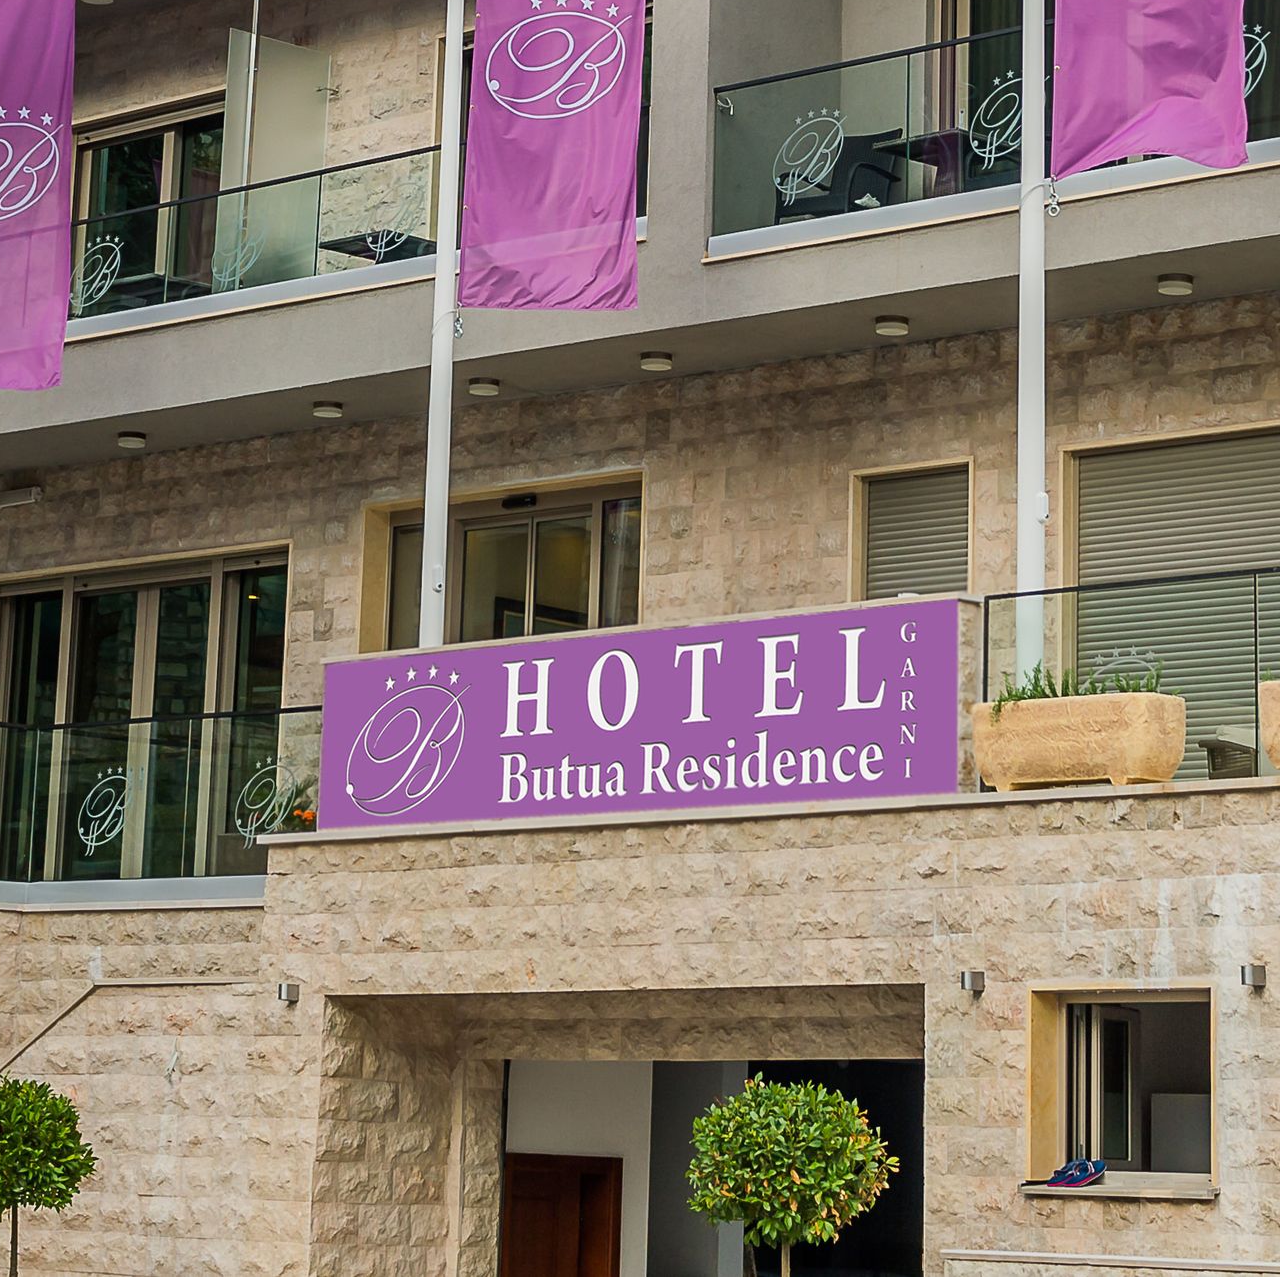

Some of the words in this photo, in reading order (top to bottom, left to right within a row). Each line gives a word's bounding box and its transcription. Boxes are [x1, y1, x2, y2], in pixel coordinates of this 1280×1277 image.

[500, 626, 887, 739] HOTEL
[899, 620, 917, 780] GARNI
[497, 752, 627, 804] Butua
[640, 730, 885, 796] Residence
